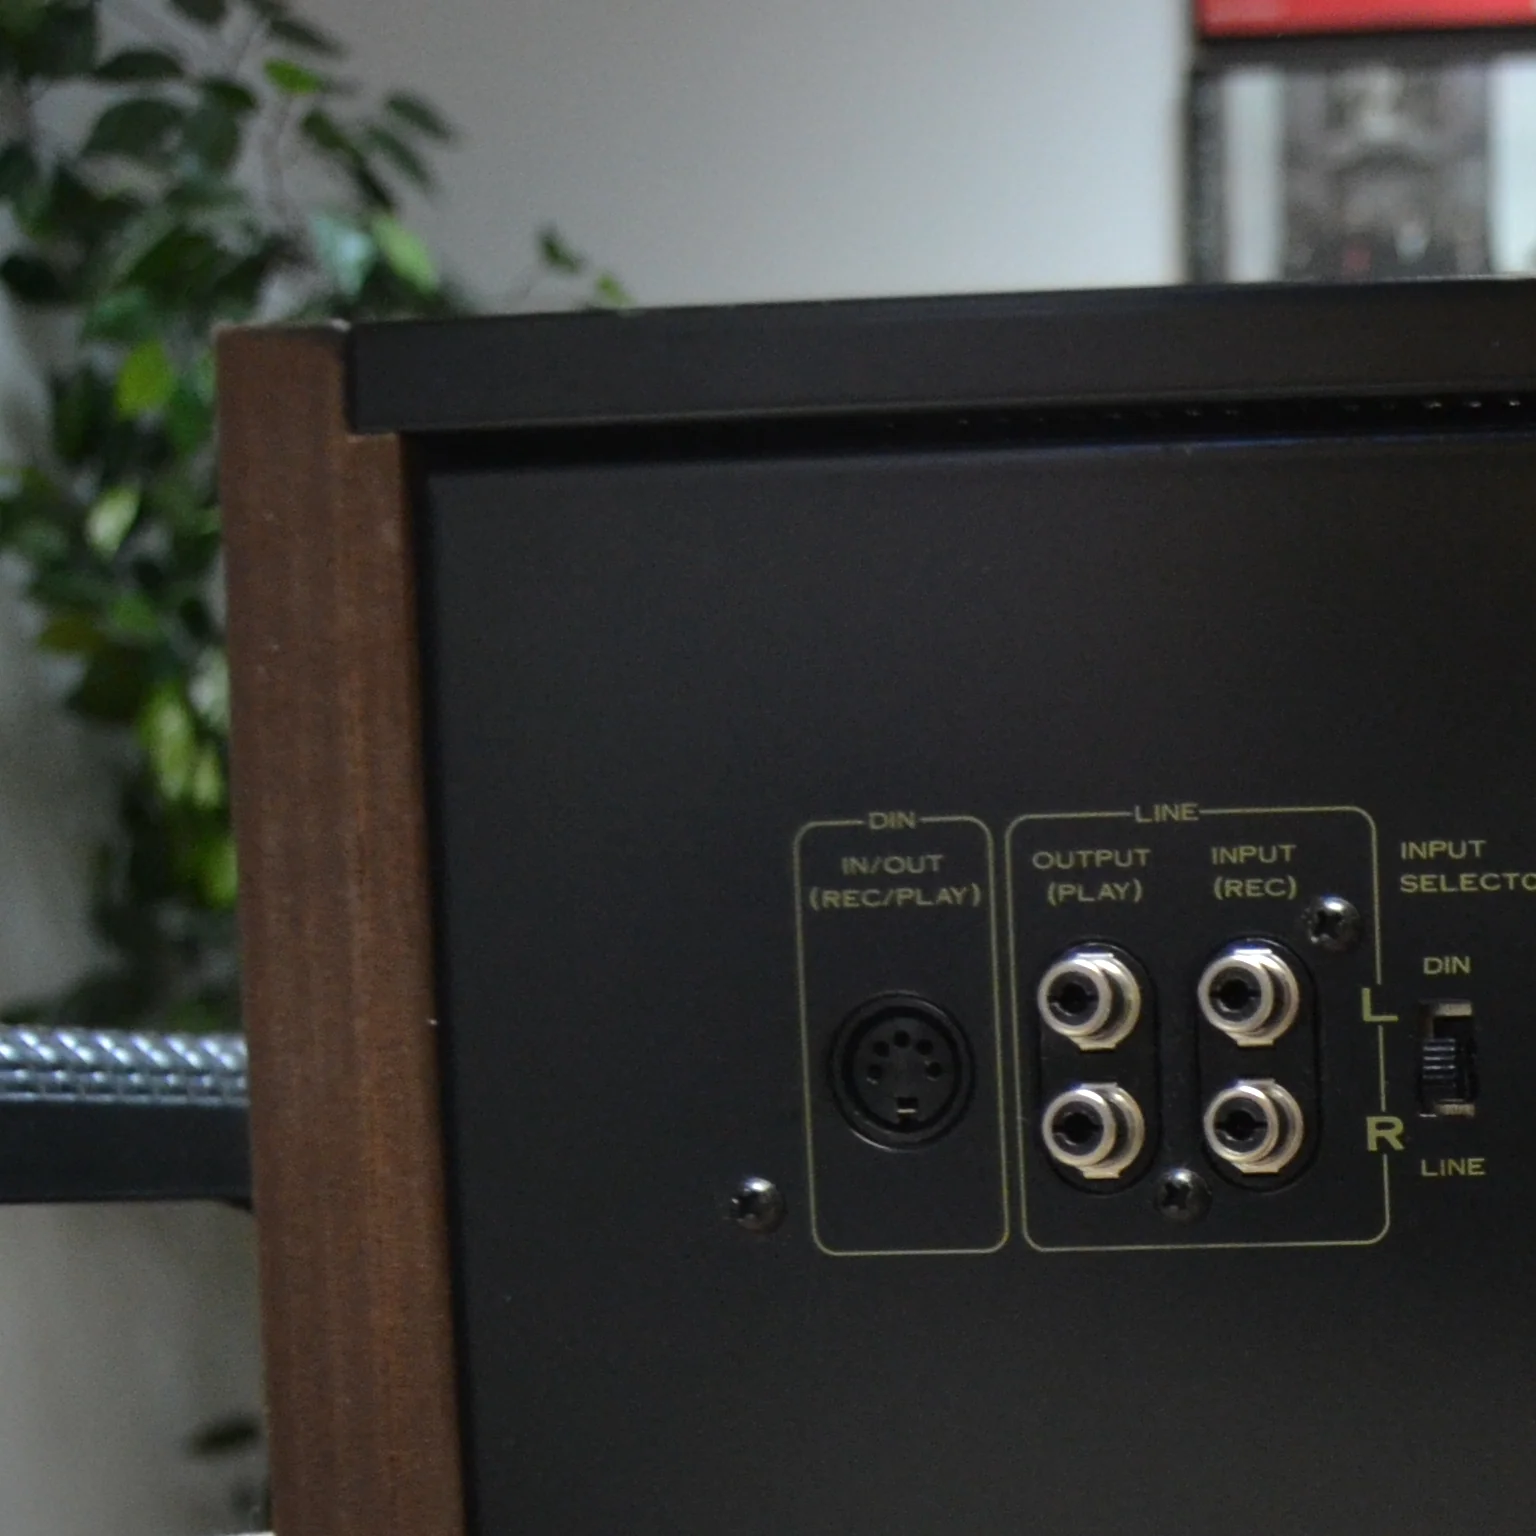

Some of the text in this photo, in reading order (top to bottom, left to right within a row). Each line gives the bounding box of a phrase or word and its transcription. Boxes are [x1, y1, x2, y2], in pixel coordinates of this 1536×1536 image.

[869, 811, 916, 830] DIN
[1134, 803, 1198, 824] LINE
[1032, 848, 1151, 870] OUTPUT
[1211, 843, 1297, 865] INPUT
[1399, 839, 1487, 860] INPUT
[841, 855, 943, 875] IN/OUT
[810, 885, 982, 910] (REC/PLAY)
[1047, 877, 1143, 905] (PLAY)
[1214, 874, 1297, 900] (REC)
[1422, 955, 1471, 976] DIN
[1361, 986, 1398, 1024] L
[1365, 1116, 1404, 1151] R
[1419, 1157, 1486, 1178] LINE
